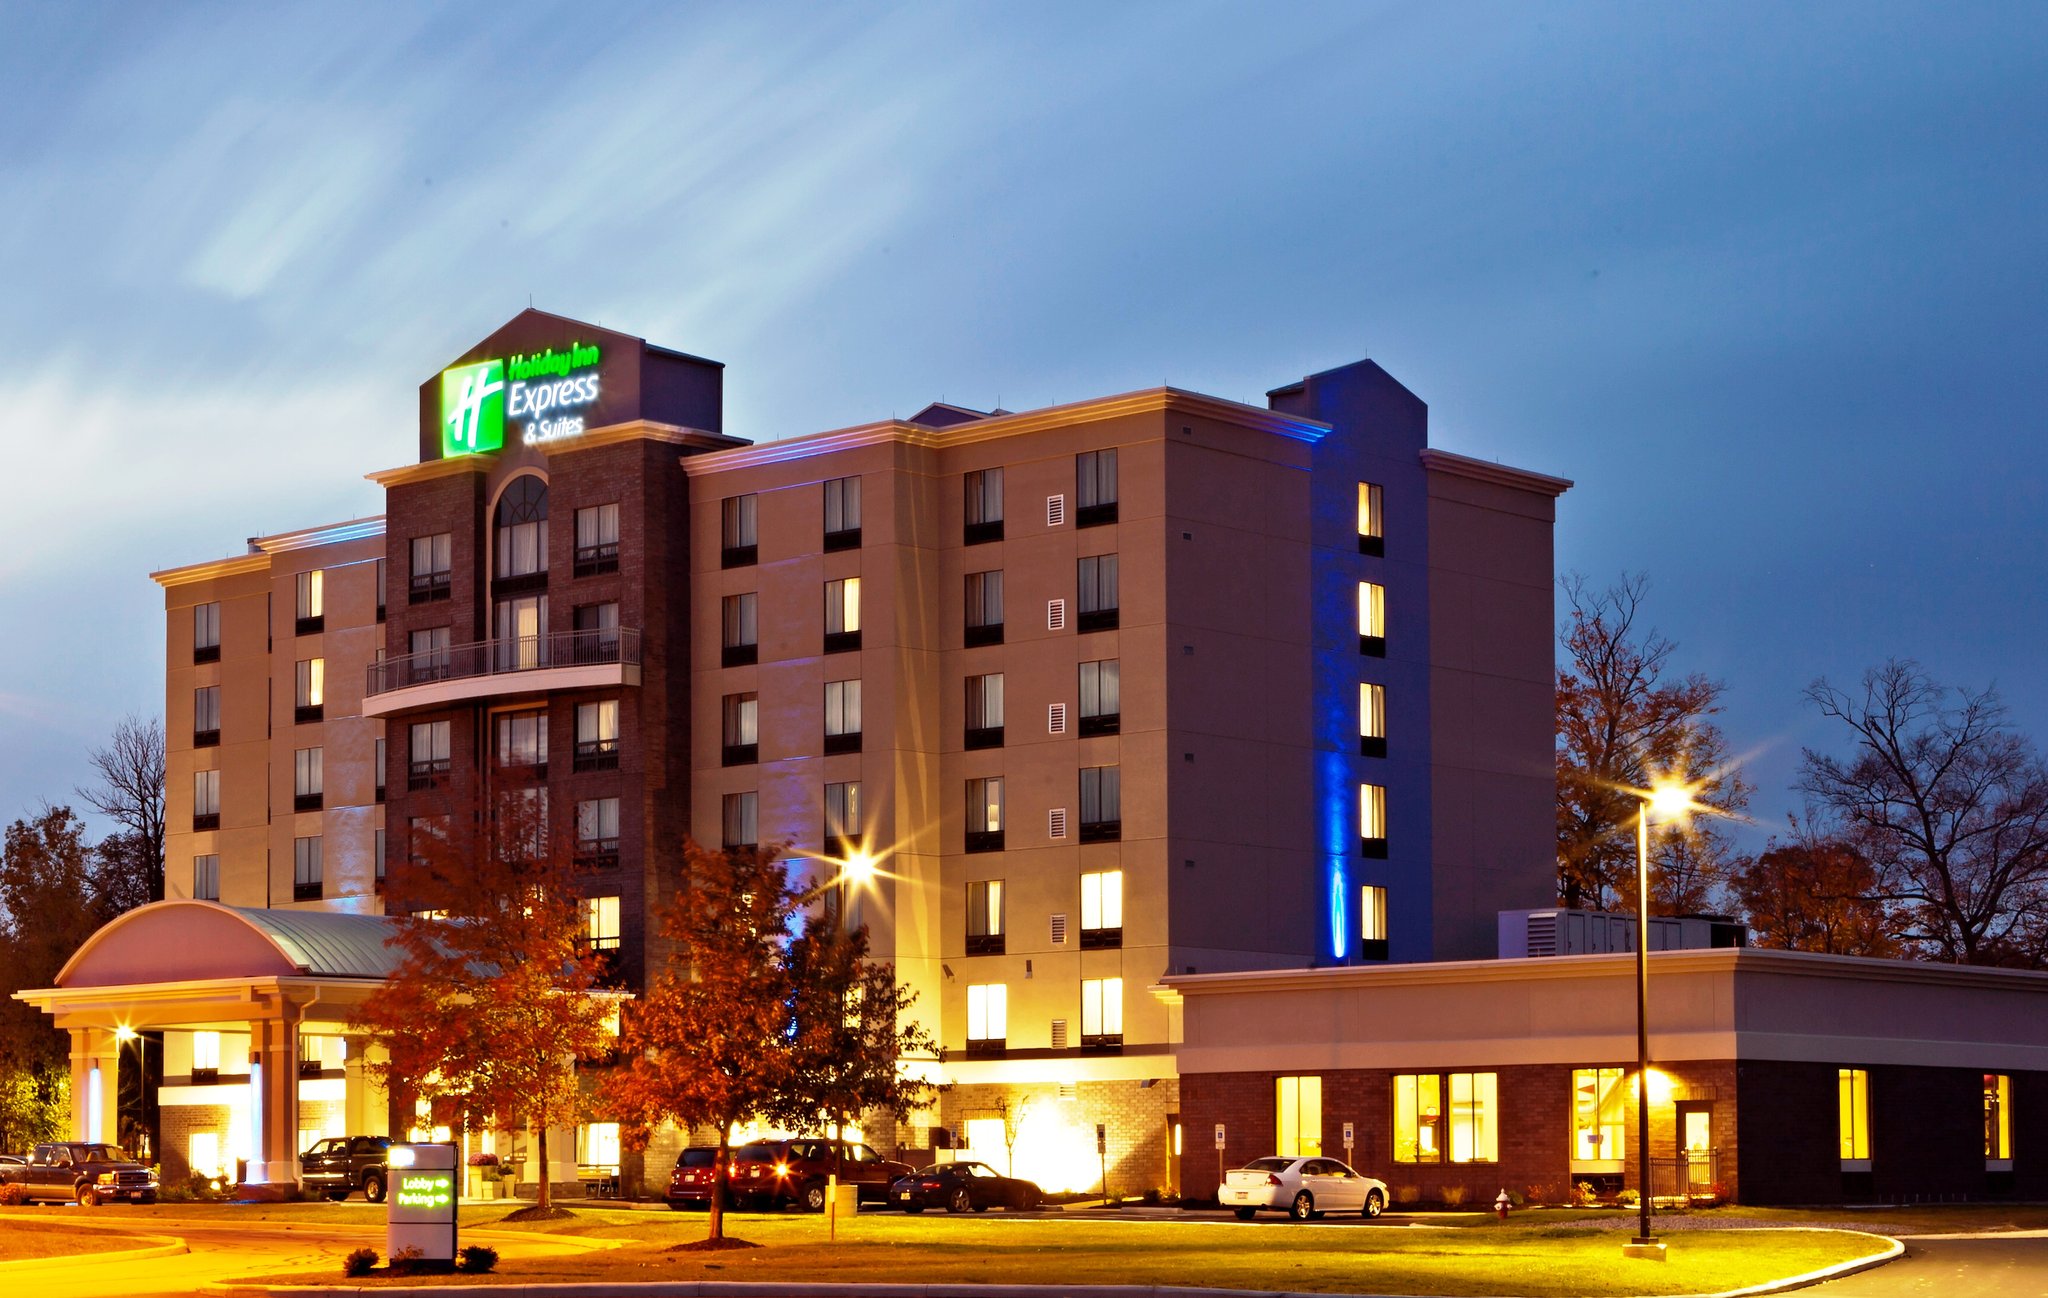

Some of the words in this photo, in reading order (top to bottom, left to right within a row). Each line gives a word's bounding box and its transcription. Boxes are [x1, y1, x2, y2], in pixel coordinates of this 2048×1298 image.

[508, 348, 572, 381] Holiday
[572, 341, 599, 369] Inn
[508, 374, 599, 419] Express
[524, 422, 537, 445] &
[538, 416, 583, 442] Suites
[403, 1177, 434, 1192] Lobby
[397, 1192, 434, 1208] Parking
